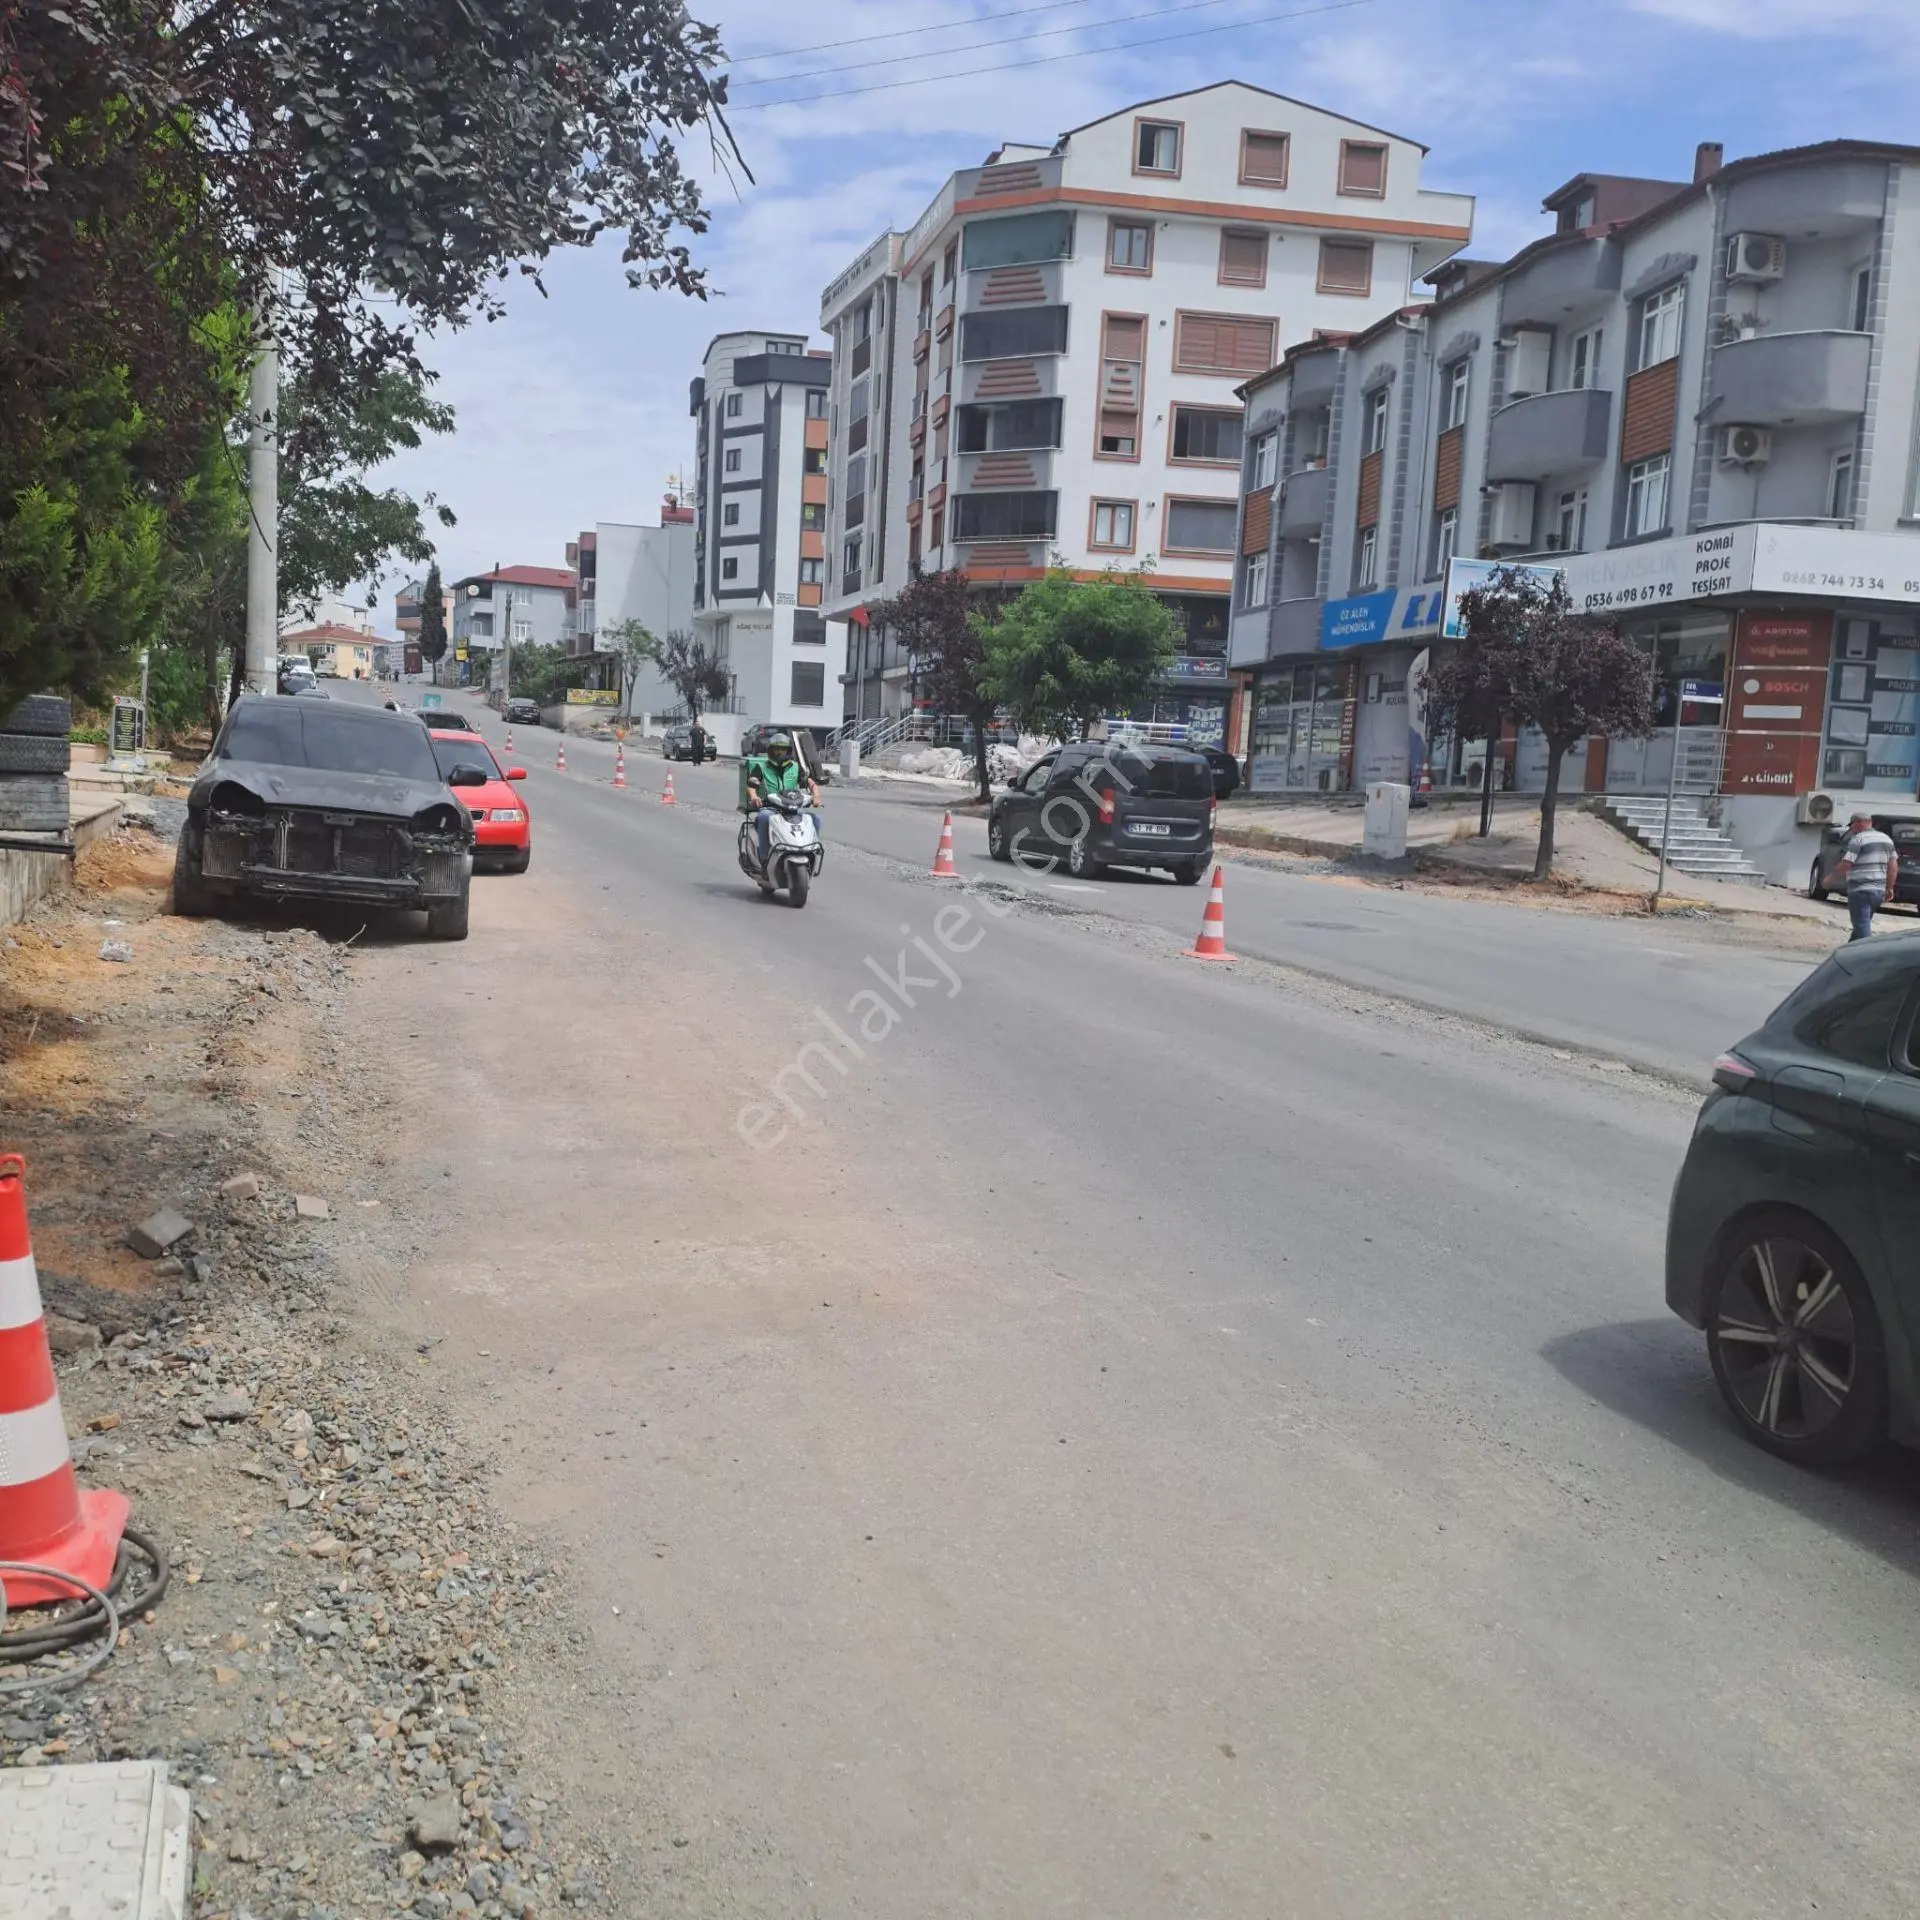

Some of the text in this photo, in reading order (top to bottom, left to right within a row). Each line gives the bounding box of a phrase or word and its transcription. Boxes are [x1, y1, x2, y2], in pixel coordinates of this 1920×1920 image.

[1696, 556, 1731, 574] PROJE
[1782, 571, 1884, 590] 0262 744 73 34
[1585, 582, 1673, 608] 0536 498 67 92
[1765, 627, 1808, 635] ARISTON
[1764, 681, 1809, 692] BOSCH
[1888, 680, 1916, 691] PROJE
[1883, 723, 1910, 734] PETEK
